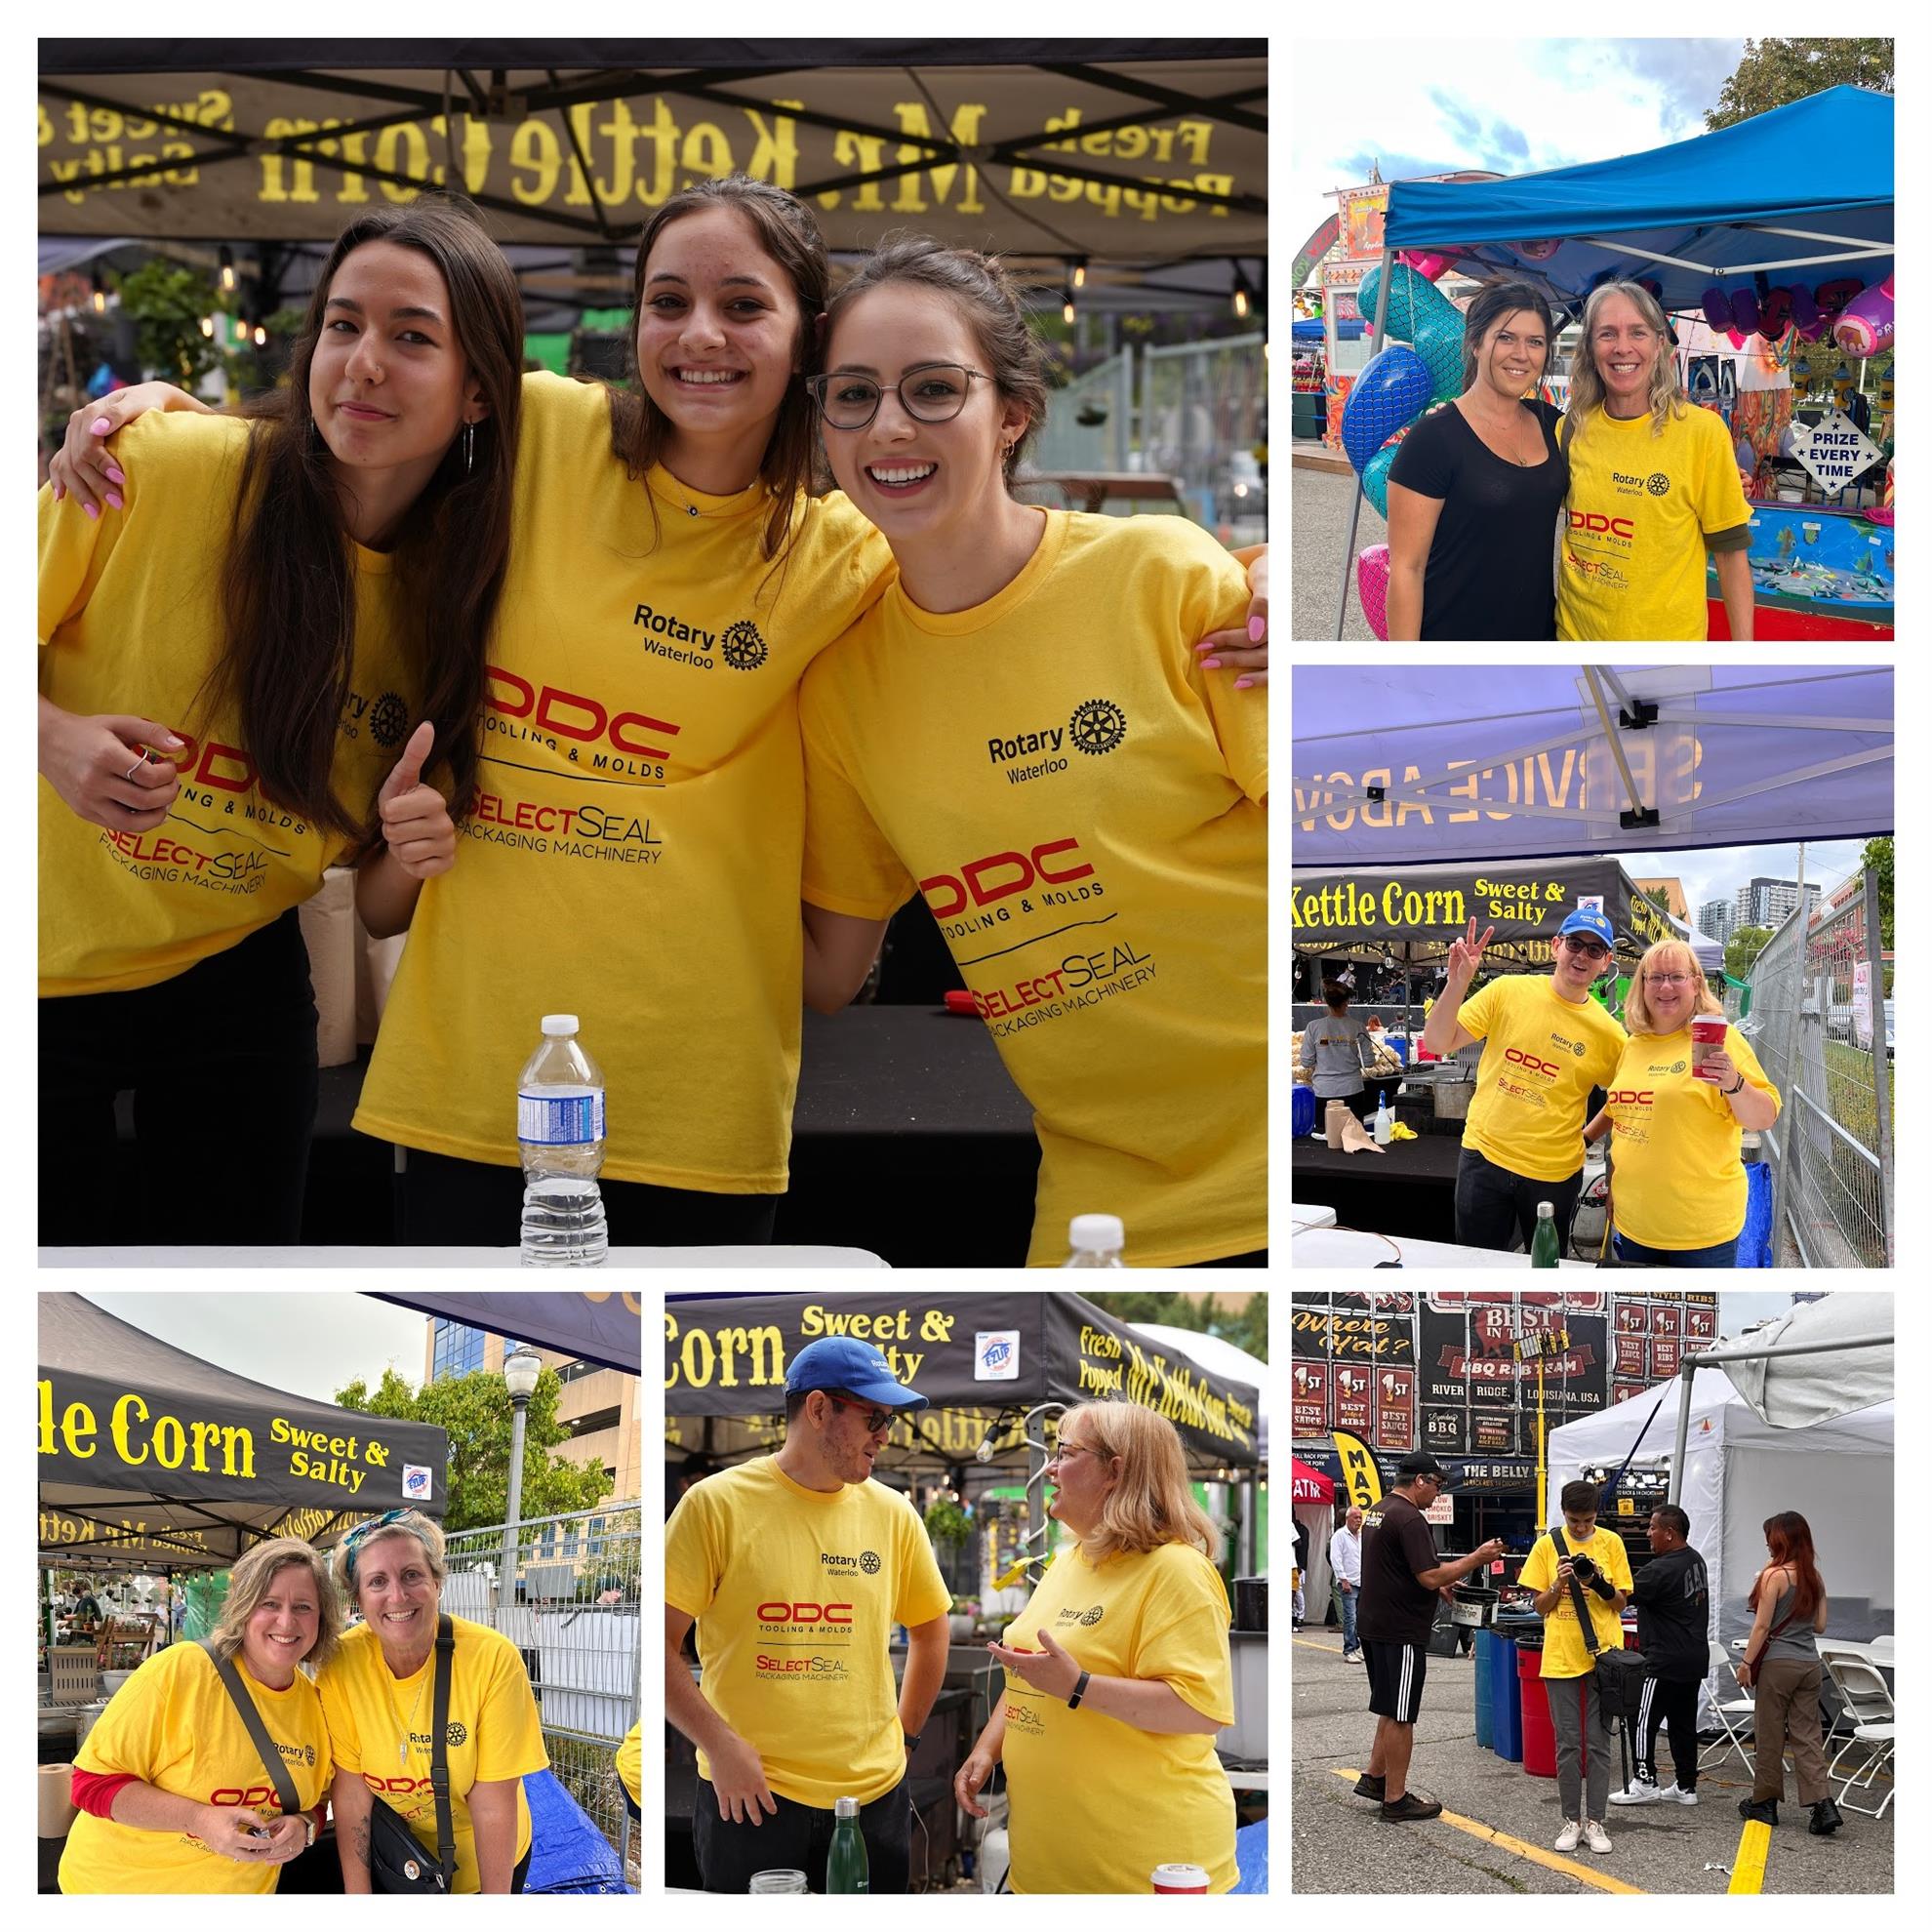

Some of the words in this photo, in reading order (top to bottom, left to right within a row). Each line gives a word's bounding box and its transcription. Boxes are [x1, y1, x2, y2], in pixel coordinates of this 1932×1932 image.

[1813, 432, 1860, 446] PRIZE
[1809, 448, 1861, 462] EVERY
[1612, 472, 1645, 488] Rotary
[1815, 463, 1854, 477] TIME
[1616, 486, 1643, 497] Waterloo
[1606, 535, 1632, 547] MOLDS
[633, 603, 716, 651] Rotary
[642, 636, 714, 669] Waterloo
[987, 727, 1064, 763] Rotary
[568, 747, 580, 762] &
[593, 753, 664, 779] MOLDS
[1006, 756, 1067, 785] Waterloo
[224, 800, 234, 814] &
[245, 805, 305, 835] MOLDS
[457, 819, 547, 853] PACKAGING
[553, 840, 663, 865] MACHINERY
[99, 833, 178, 881] PACKAGING
[181, 870, 266, 895] MACHINERY
[1021, 899, 1034, 913] &
[1041, 881, 1104, 906] MOLDS
[1473, 878, 1540, 900] Sweet
[1545, 881, 1566, 902] &
[1382, 881, 1466, 926] Corn
[1488, 900, 1548, 926] Salty
[1062, 963, 1157, 1012] MACHINERY
[1550, 1032, 1574, 1048] Rotary
[1505, 1048, 1560, 1077] ODC
[1686, 1294, 1714, 1304] RIBS
[801, 1305, 911, 1340] Sweet
[920, 1309, 954, 1343] &
[1292, 1311, 1389, 1334] Where
[1620, 1309, 1641, 1332] 1ST
[1656, 1312, 1674, 1335] 1ST
[1691, 1314, 1710, 1337] 1ST
[1080, 1326, 1122, 1358] Fresh
[1487, 1327, 1503, 1339] IN
[1079, 1358, 1123, 1396] Popped
[1294, 1367, 1321, 1396] 1ST
[1339, 1370, 1365, 1398] 1ST
[1382, 1374, 1408, 1402] 1ST
[1431, 1385, 1464, 1395] RIVER
[1581, 1391, 1600, 1403] USA
[1294, 1416, 1321, 1426] SAUCE
[1295, 1406, 1321, 1415] BEST
[1382, 1411, 1407, 1421] BEST
[109, 1393, 257, 1478] Corn
[1382, 1422, 1407, 1431] SAUCE
[1428, 1422, 1458, 1434] BBQ
[270, 1417, 359, 1460] Sweet
[365, 1440, 389, 1468] &
[289, 1449, 367, 1494] Salty
[1463, 1465, 1488, 1477] THE
[1493, 1465, 1530, 1478] BELLY
[821, 1552, 858, 1567] Rotary
[826, 1568, 859, 1577] Waterloo
[757, 1602, 853, 1624] ODC
[756, 1655, 849, 1672] SELECTSEAL
